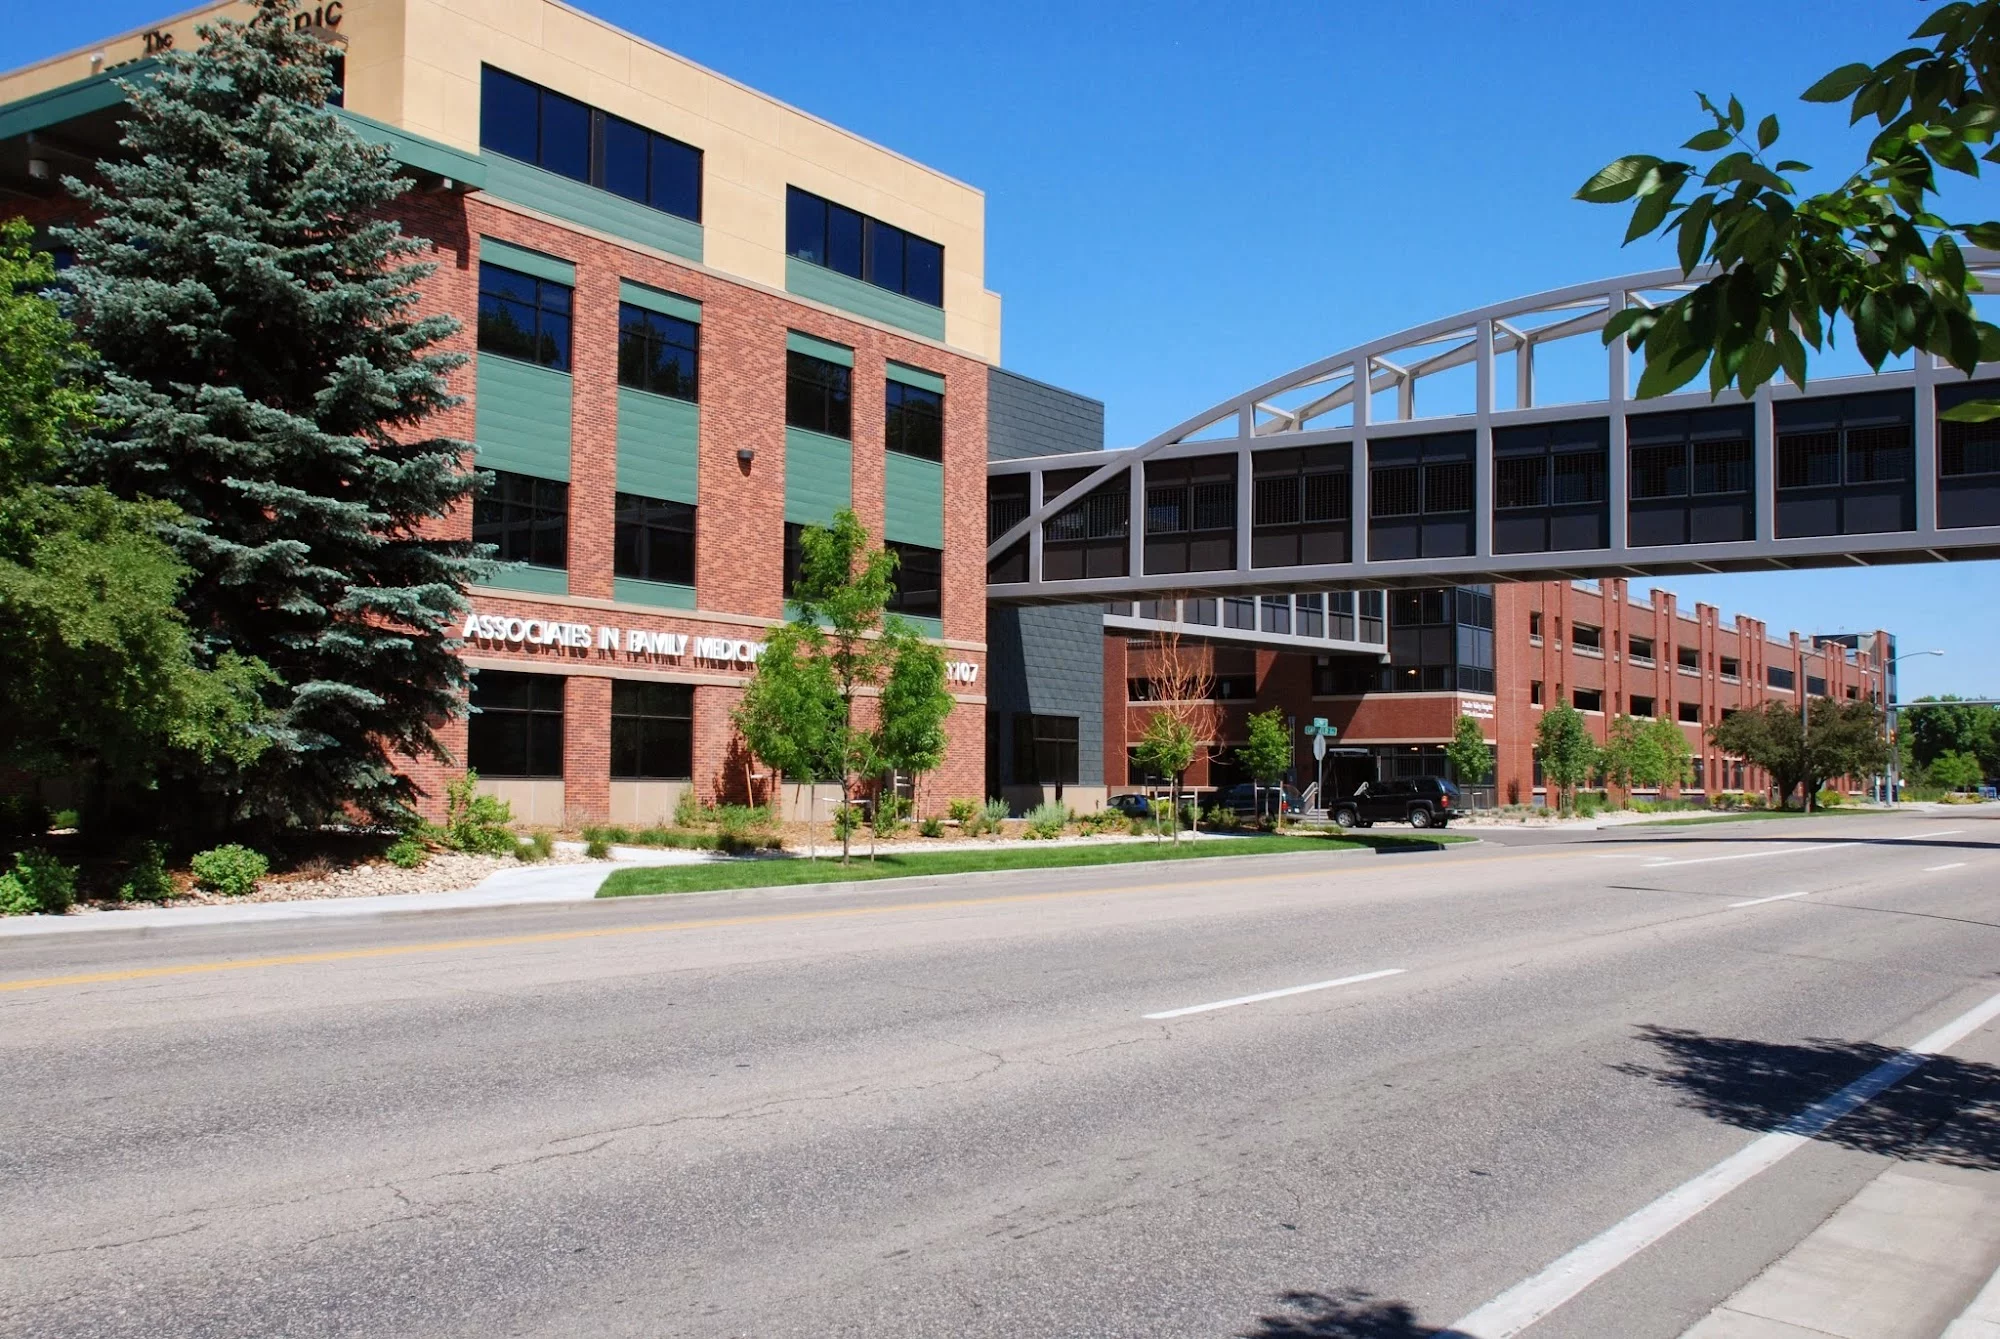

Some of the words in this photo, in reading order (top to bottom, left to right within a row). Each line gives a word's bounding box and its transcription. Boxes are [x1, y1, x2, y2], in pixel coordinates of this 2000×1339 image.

[462, 614, 592, 648] ASSOCIATES
[597, 626, 620, 650] IN
[627, 629, 689, 656] FAMILY
